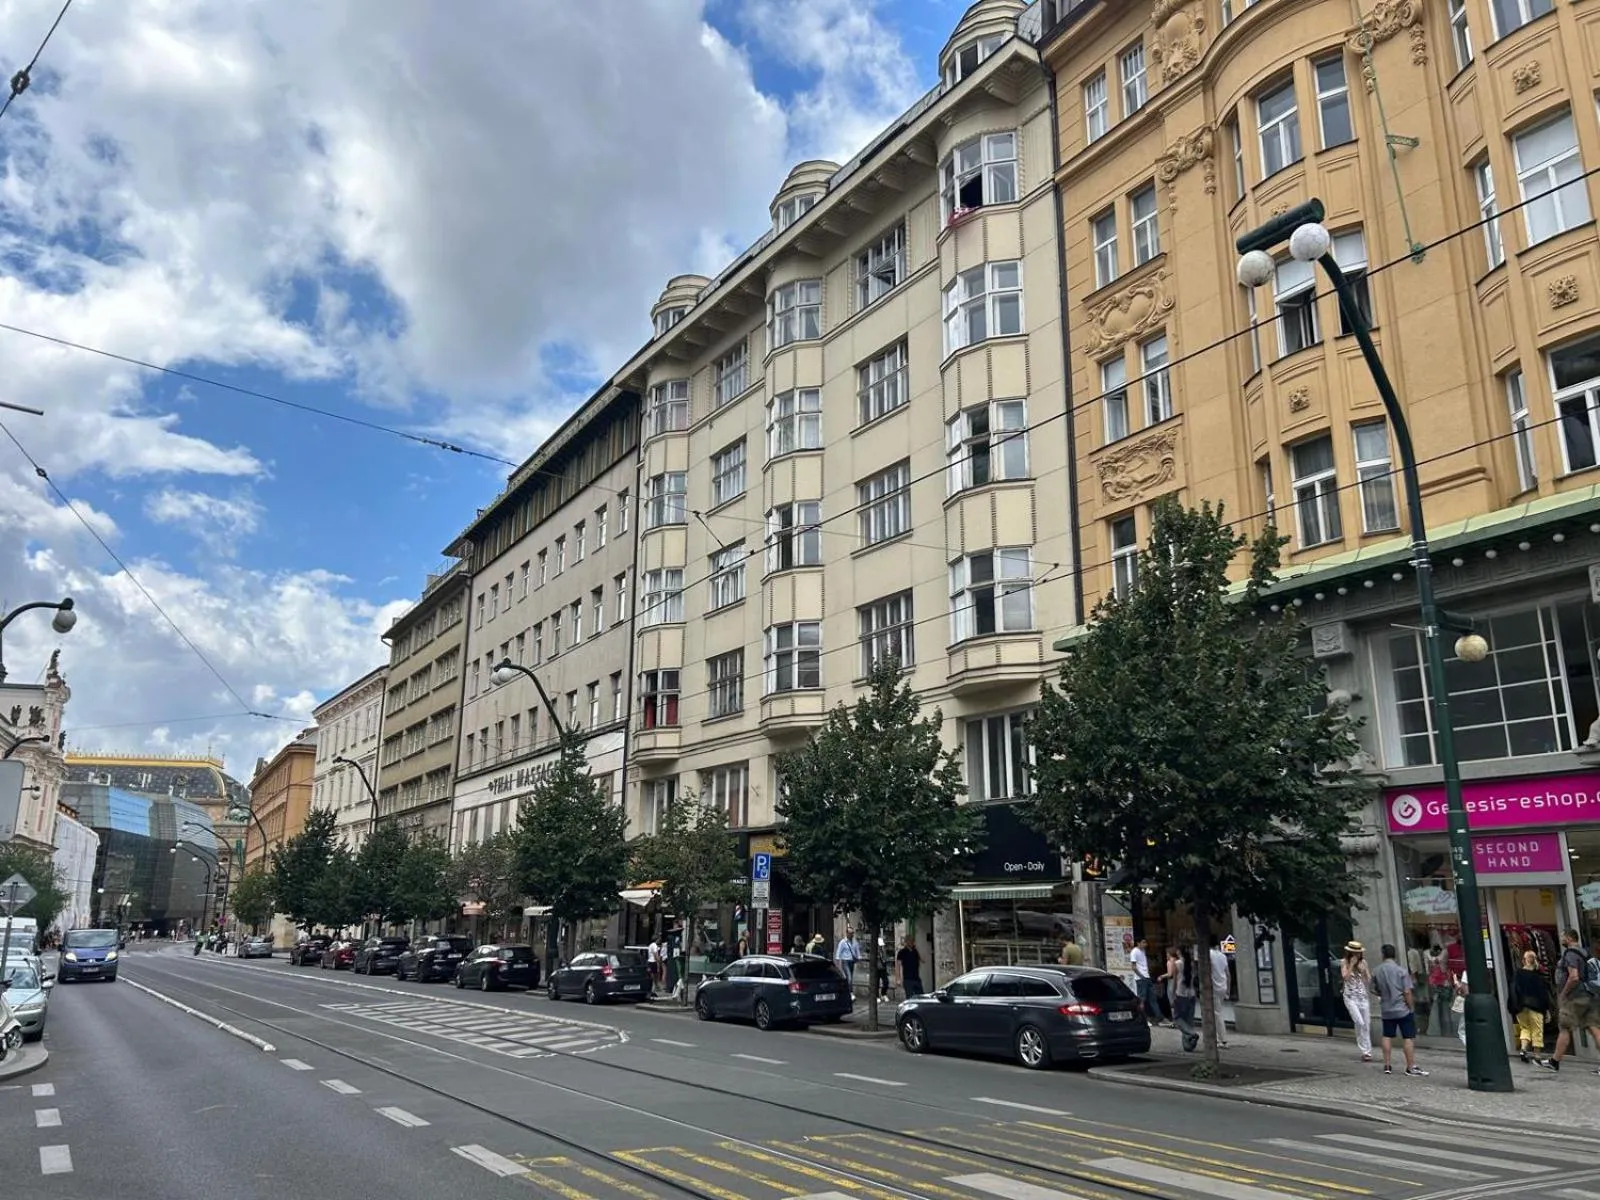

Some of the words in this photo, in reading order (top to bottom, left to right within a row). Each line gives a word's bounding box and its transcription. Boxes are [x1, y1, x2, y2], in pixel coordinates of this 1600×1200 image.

[493, 773, 513, 795] THAI
[1426, 790, 1600, 816] Geesis-eshop.
[1475, 841, 1540, 855] SECOND
[757, 855, 767, 872] P
[1003, 862, 1024, 872] Open
[1027, 861, 1045, 871] Daily
[1487, 857, 1532, 868] HAND
